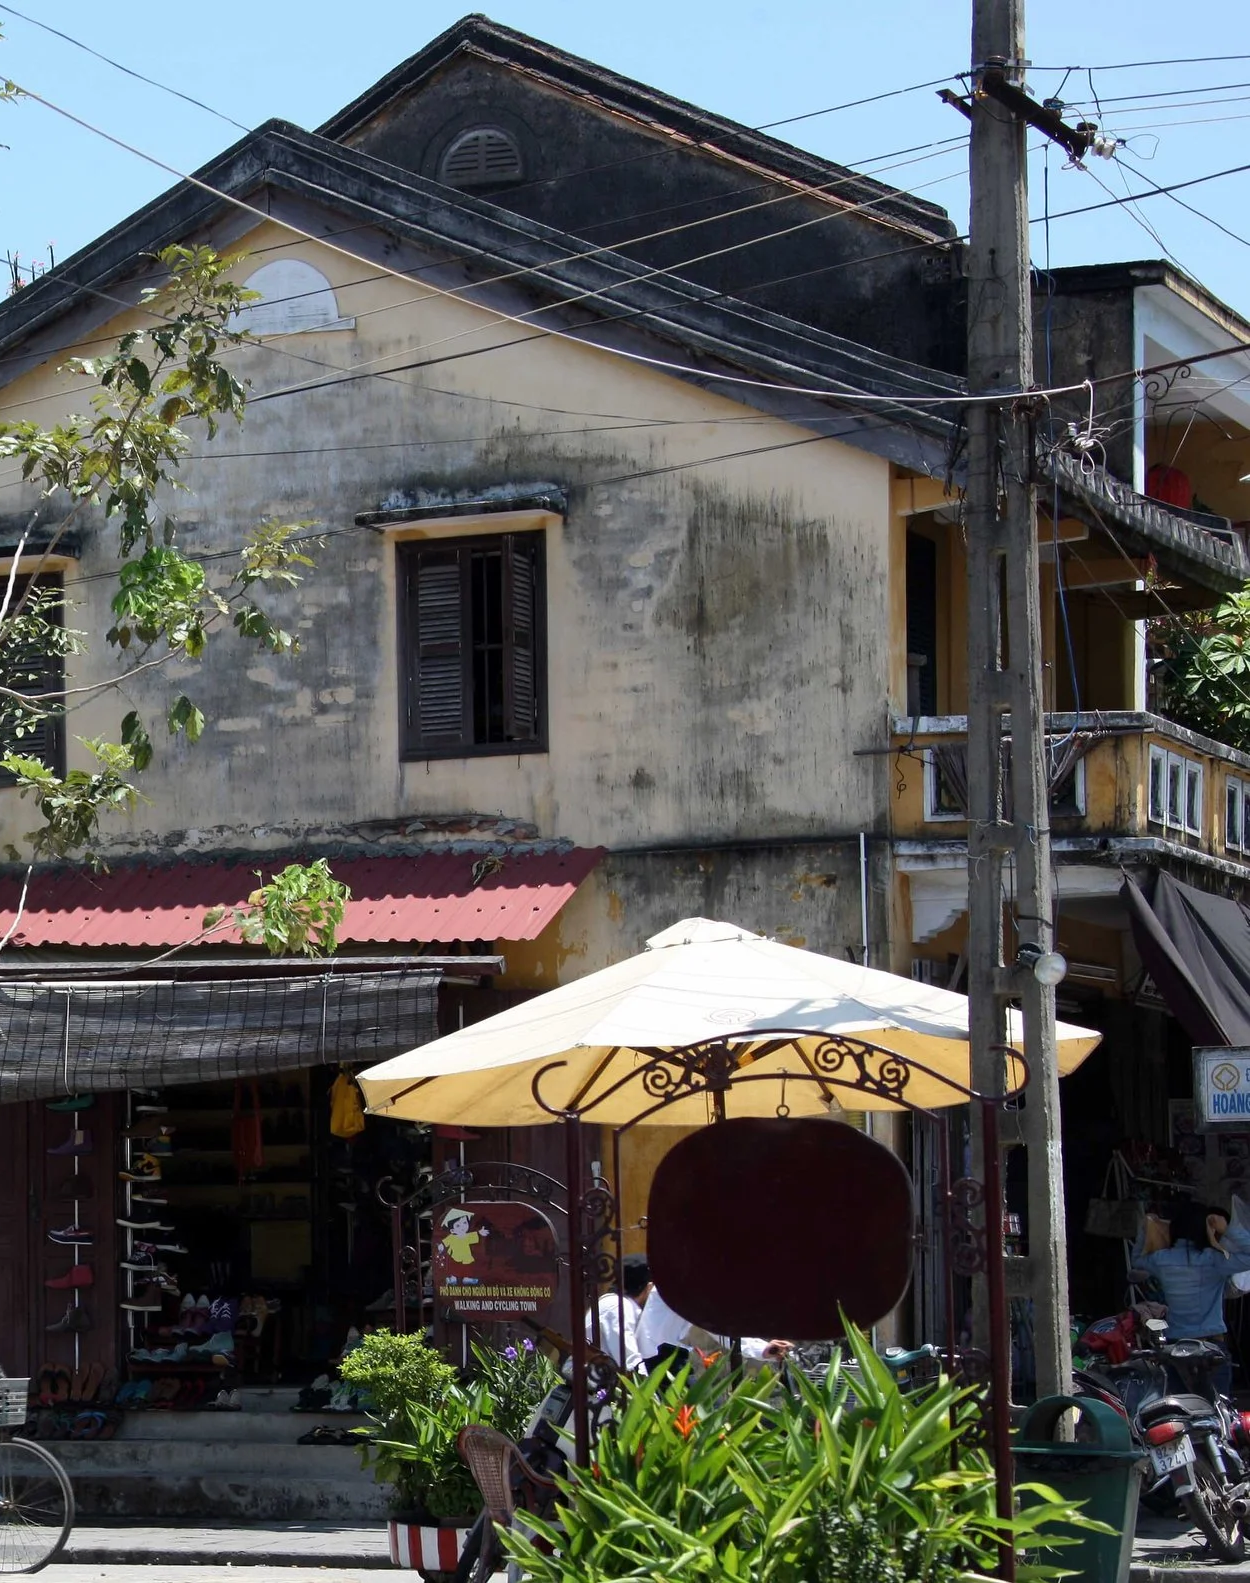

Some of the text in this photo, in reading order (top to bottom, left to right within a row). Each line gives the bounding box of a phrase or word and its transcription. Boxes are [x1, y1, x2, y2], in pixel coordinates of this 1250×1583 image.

[462, 1286, 471, 1296] CHO
[507, 1287, 513, 1297] XE
[454, 1300, 537, 1311] WALKING AND CYCLING TOWN
